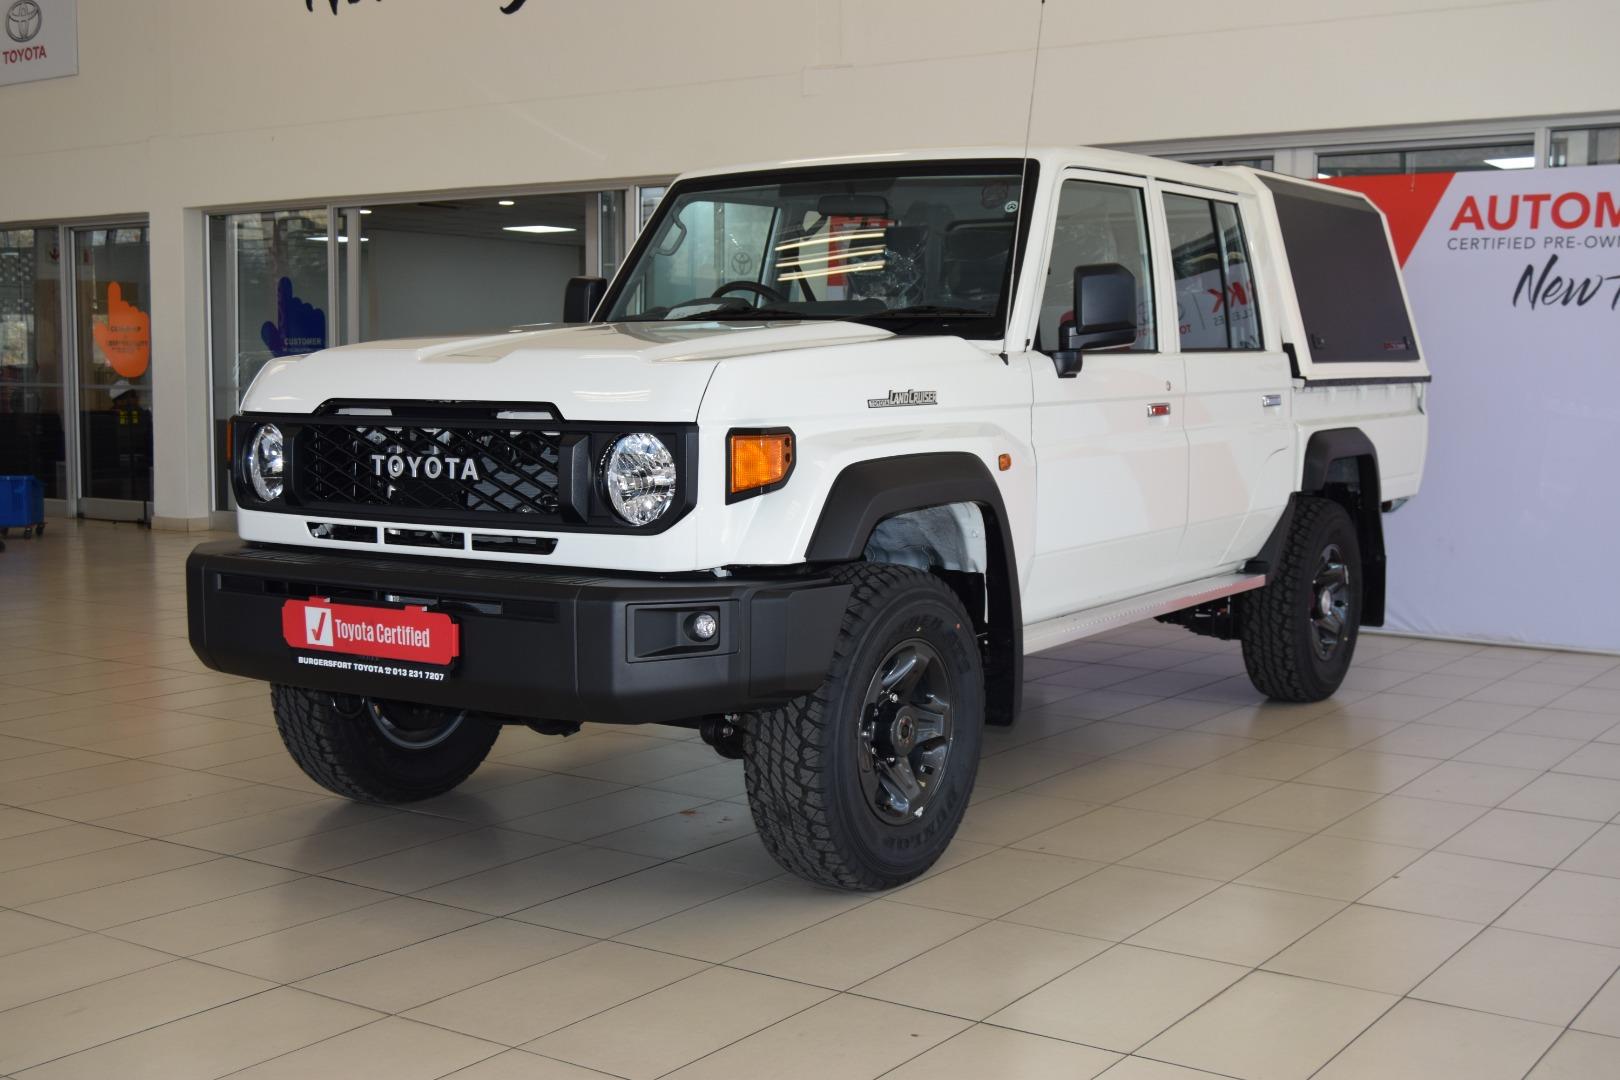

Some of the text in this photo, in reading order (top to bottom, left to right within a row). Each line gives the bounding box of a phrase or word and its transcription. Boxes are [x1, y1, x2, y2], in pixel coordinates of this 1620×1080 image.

[2, 45, 47, 65] TOYOTA
[1447, 235, 1620, 251] CERTIFIED PRE-OW
[1512, 253, 1604, 311] New
[371, 454, 479, 481] TOYOTA
[335, 619, 430, 648] Toyota Certified
[298, 656, 444, 681] BURGERSFORT TOYOTA 013 231 7207
